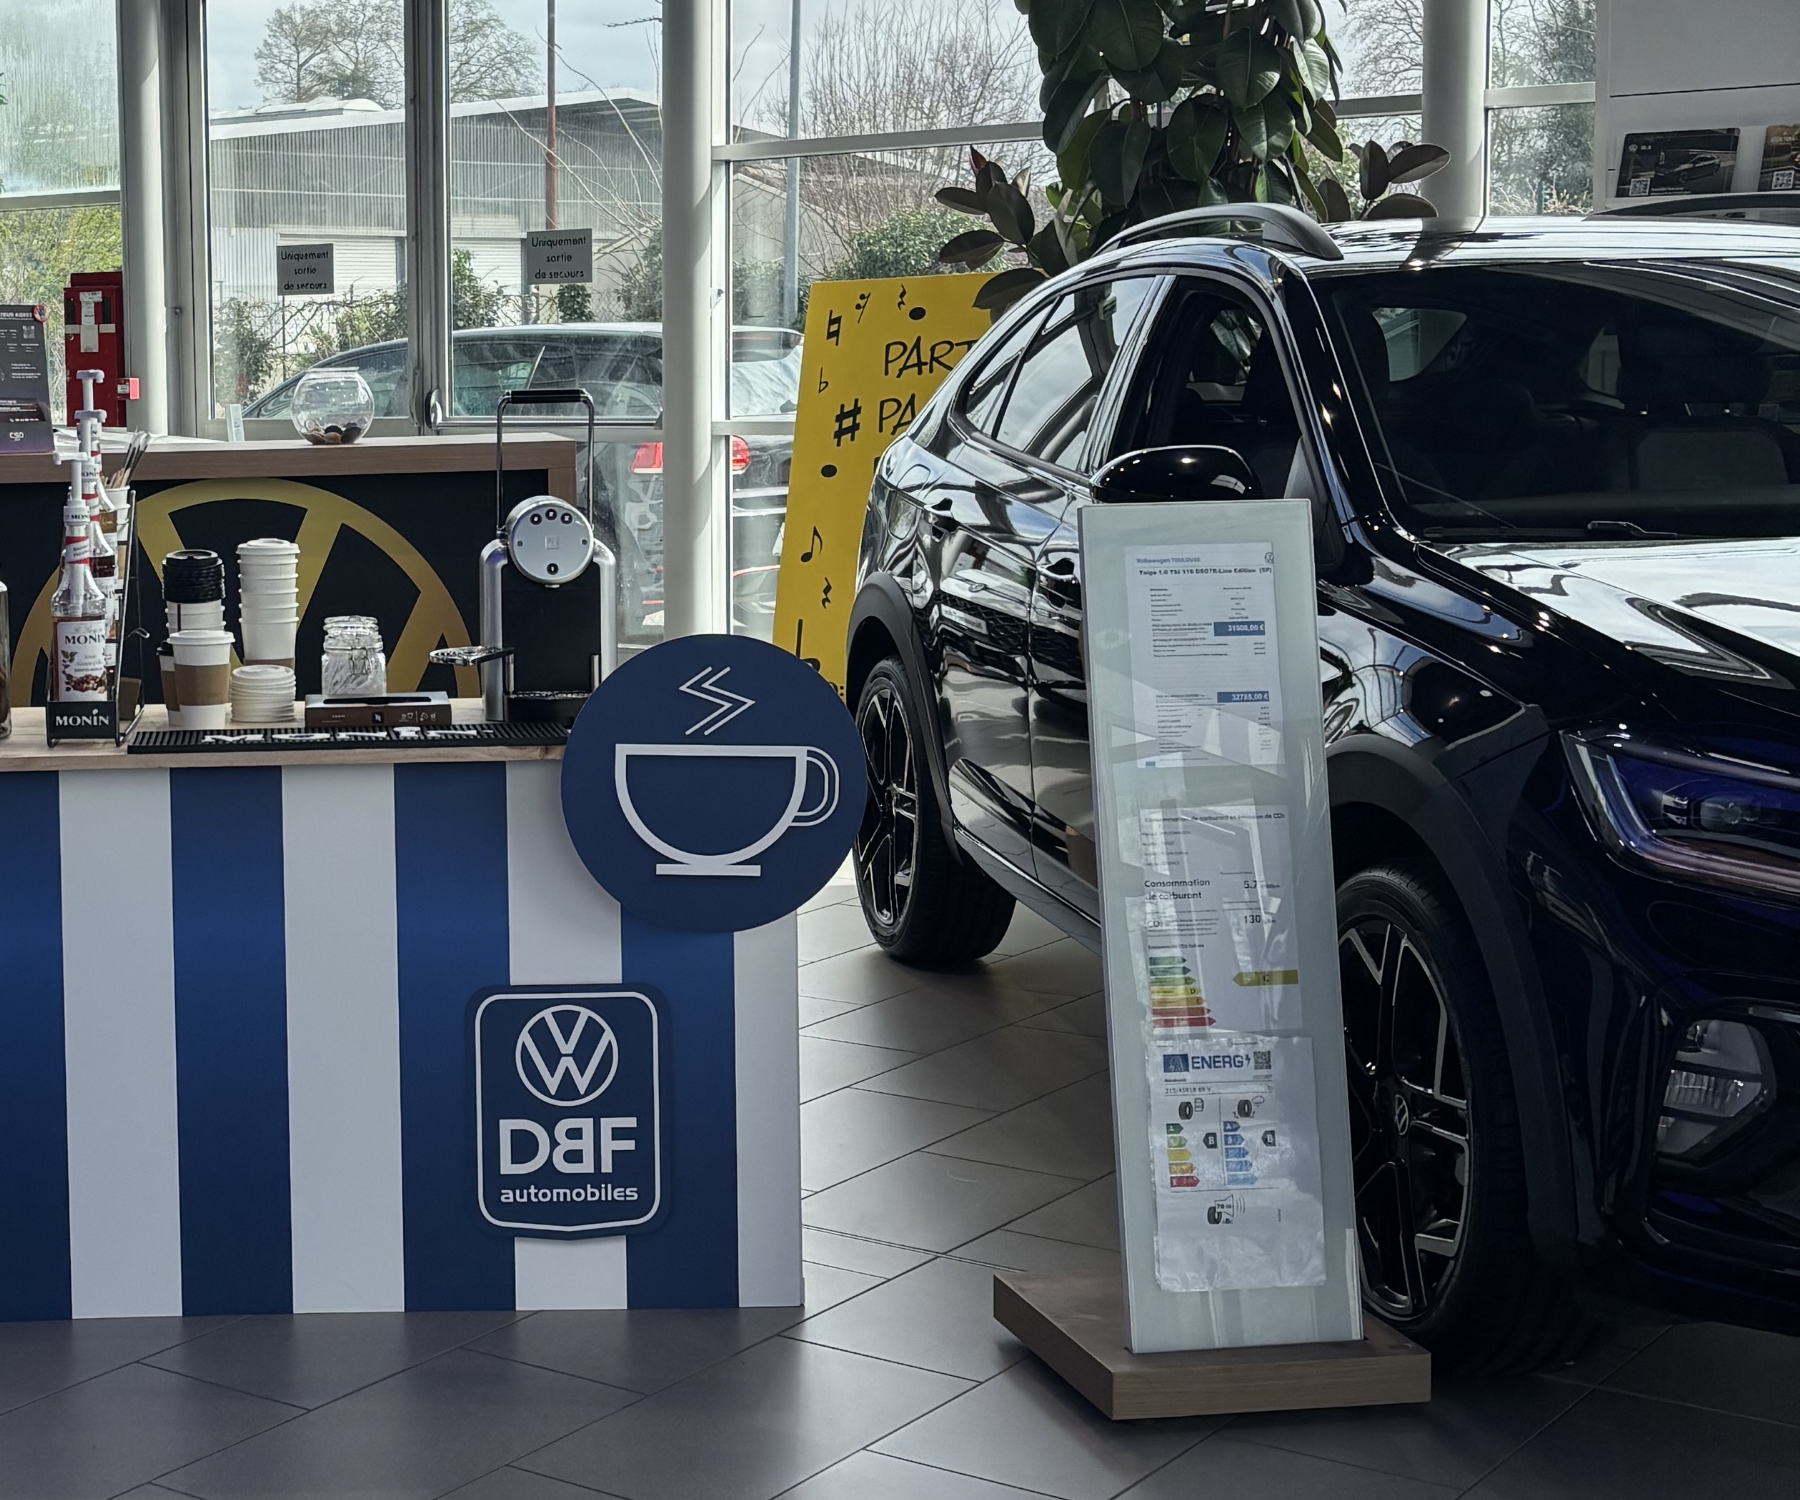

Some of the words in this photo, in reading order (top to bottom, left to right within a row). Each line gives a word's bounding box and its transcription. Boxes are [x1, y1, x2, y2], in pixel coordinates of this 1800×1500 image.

[532, 236, 586, 249] Uniquement
[281, 250, 329, 262] Uniquement
[546, 252, 572, 263] sortie
[294, 266, 317, 275] sortie
[534, 269, 546, 279] de
[549, 270, 584, 279] secours
[283, 281, 294, 290] de
[297, 282, 327, 290] secours
[55, 708, 110, 727] MONIN
[202, 726, 477, 743] MONIN
[1144, 878, 1211, 888] Consommation
[1158, 891, 1202, 901] carburant
[1244, 914, 1262, 924] 130
[1191, 1054, 1244, 1070] ENERG
[499, 1117, 637, 1175] DBF
[500, 1184, 638, 1203] automobiles
